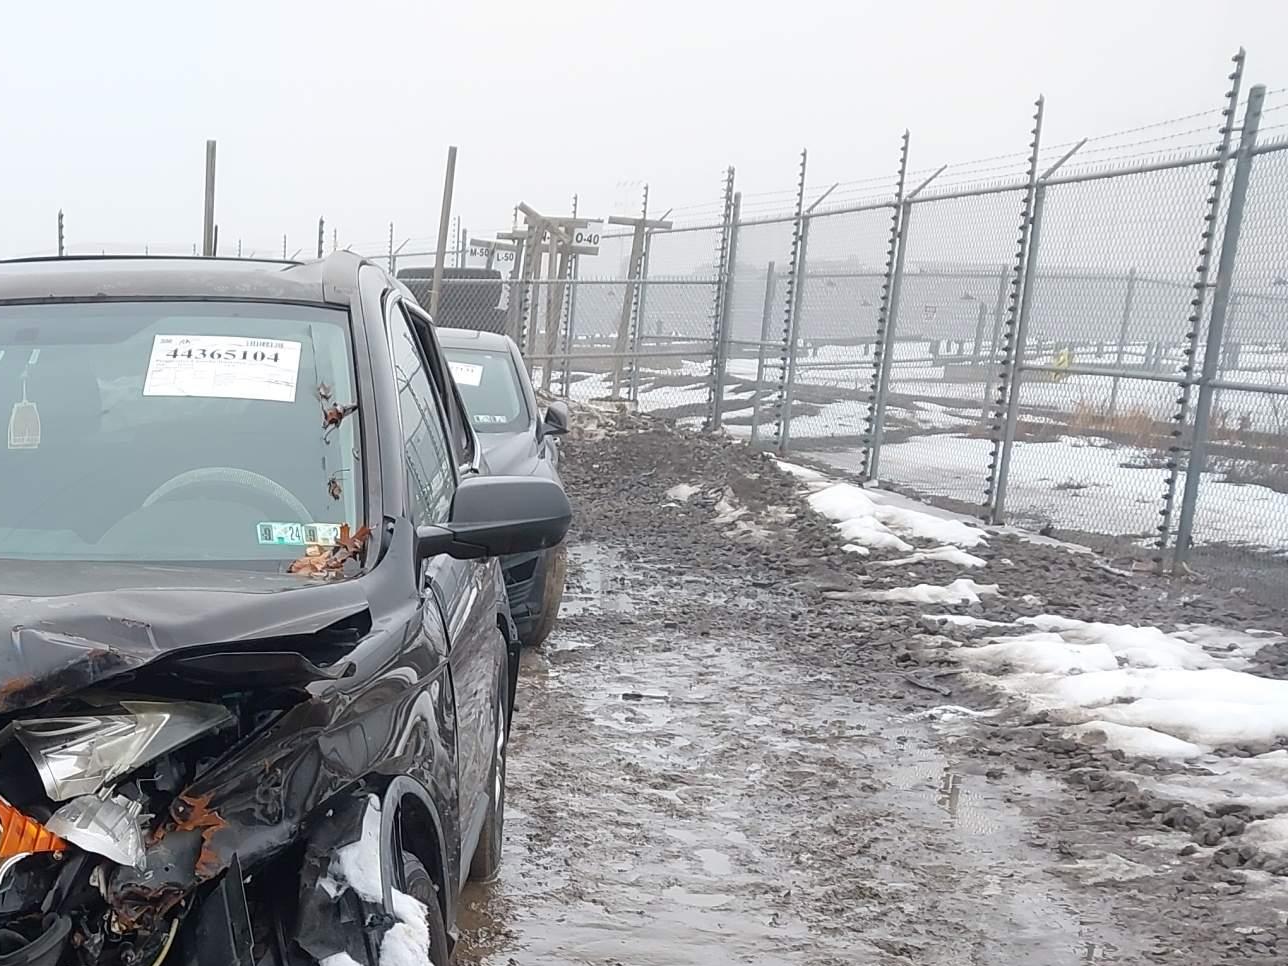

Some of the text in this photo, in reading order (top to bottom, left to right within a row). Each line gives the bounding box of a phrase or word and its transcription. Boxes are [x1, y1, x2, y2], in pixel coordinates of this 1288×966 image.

[575, 232, 600, 245] O-40
[496, 252, 514, 262] L-50
[165, 347, 281, 363] 44365104
[288, 526, 301, 541] 24
